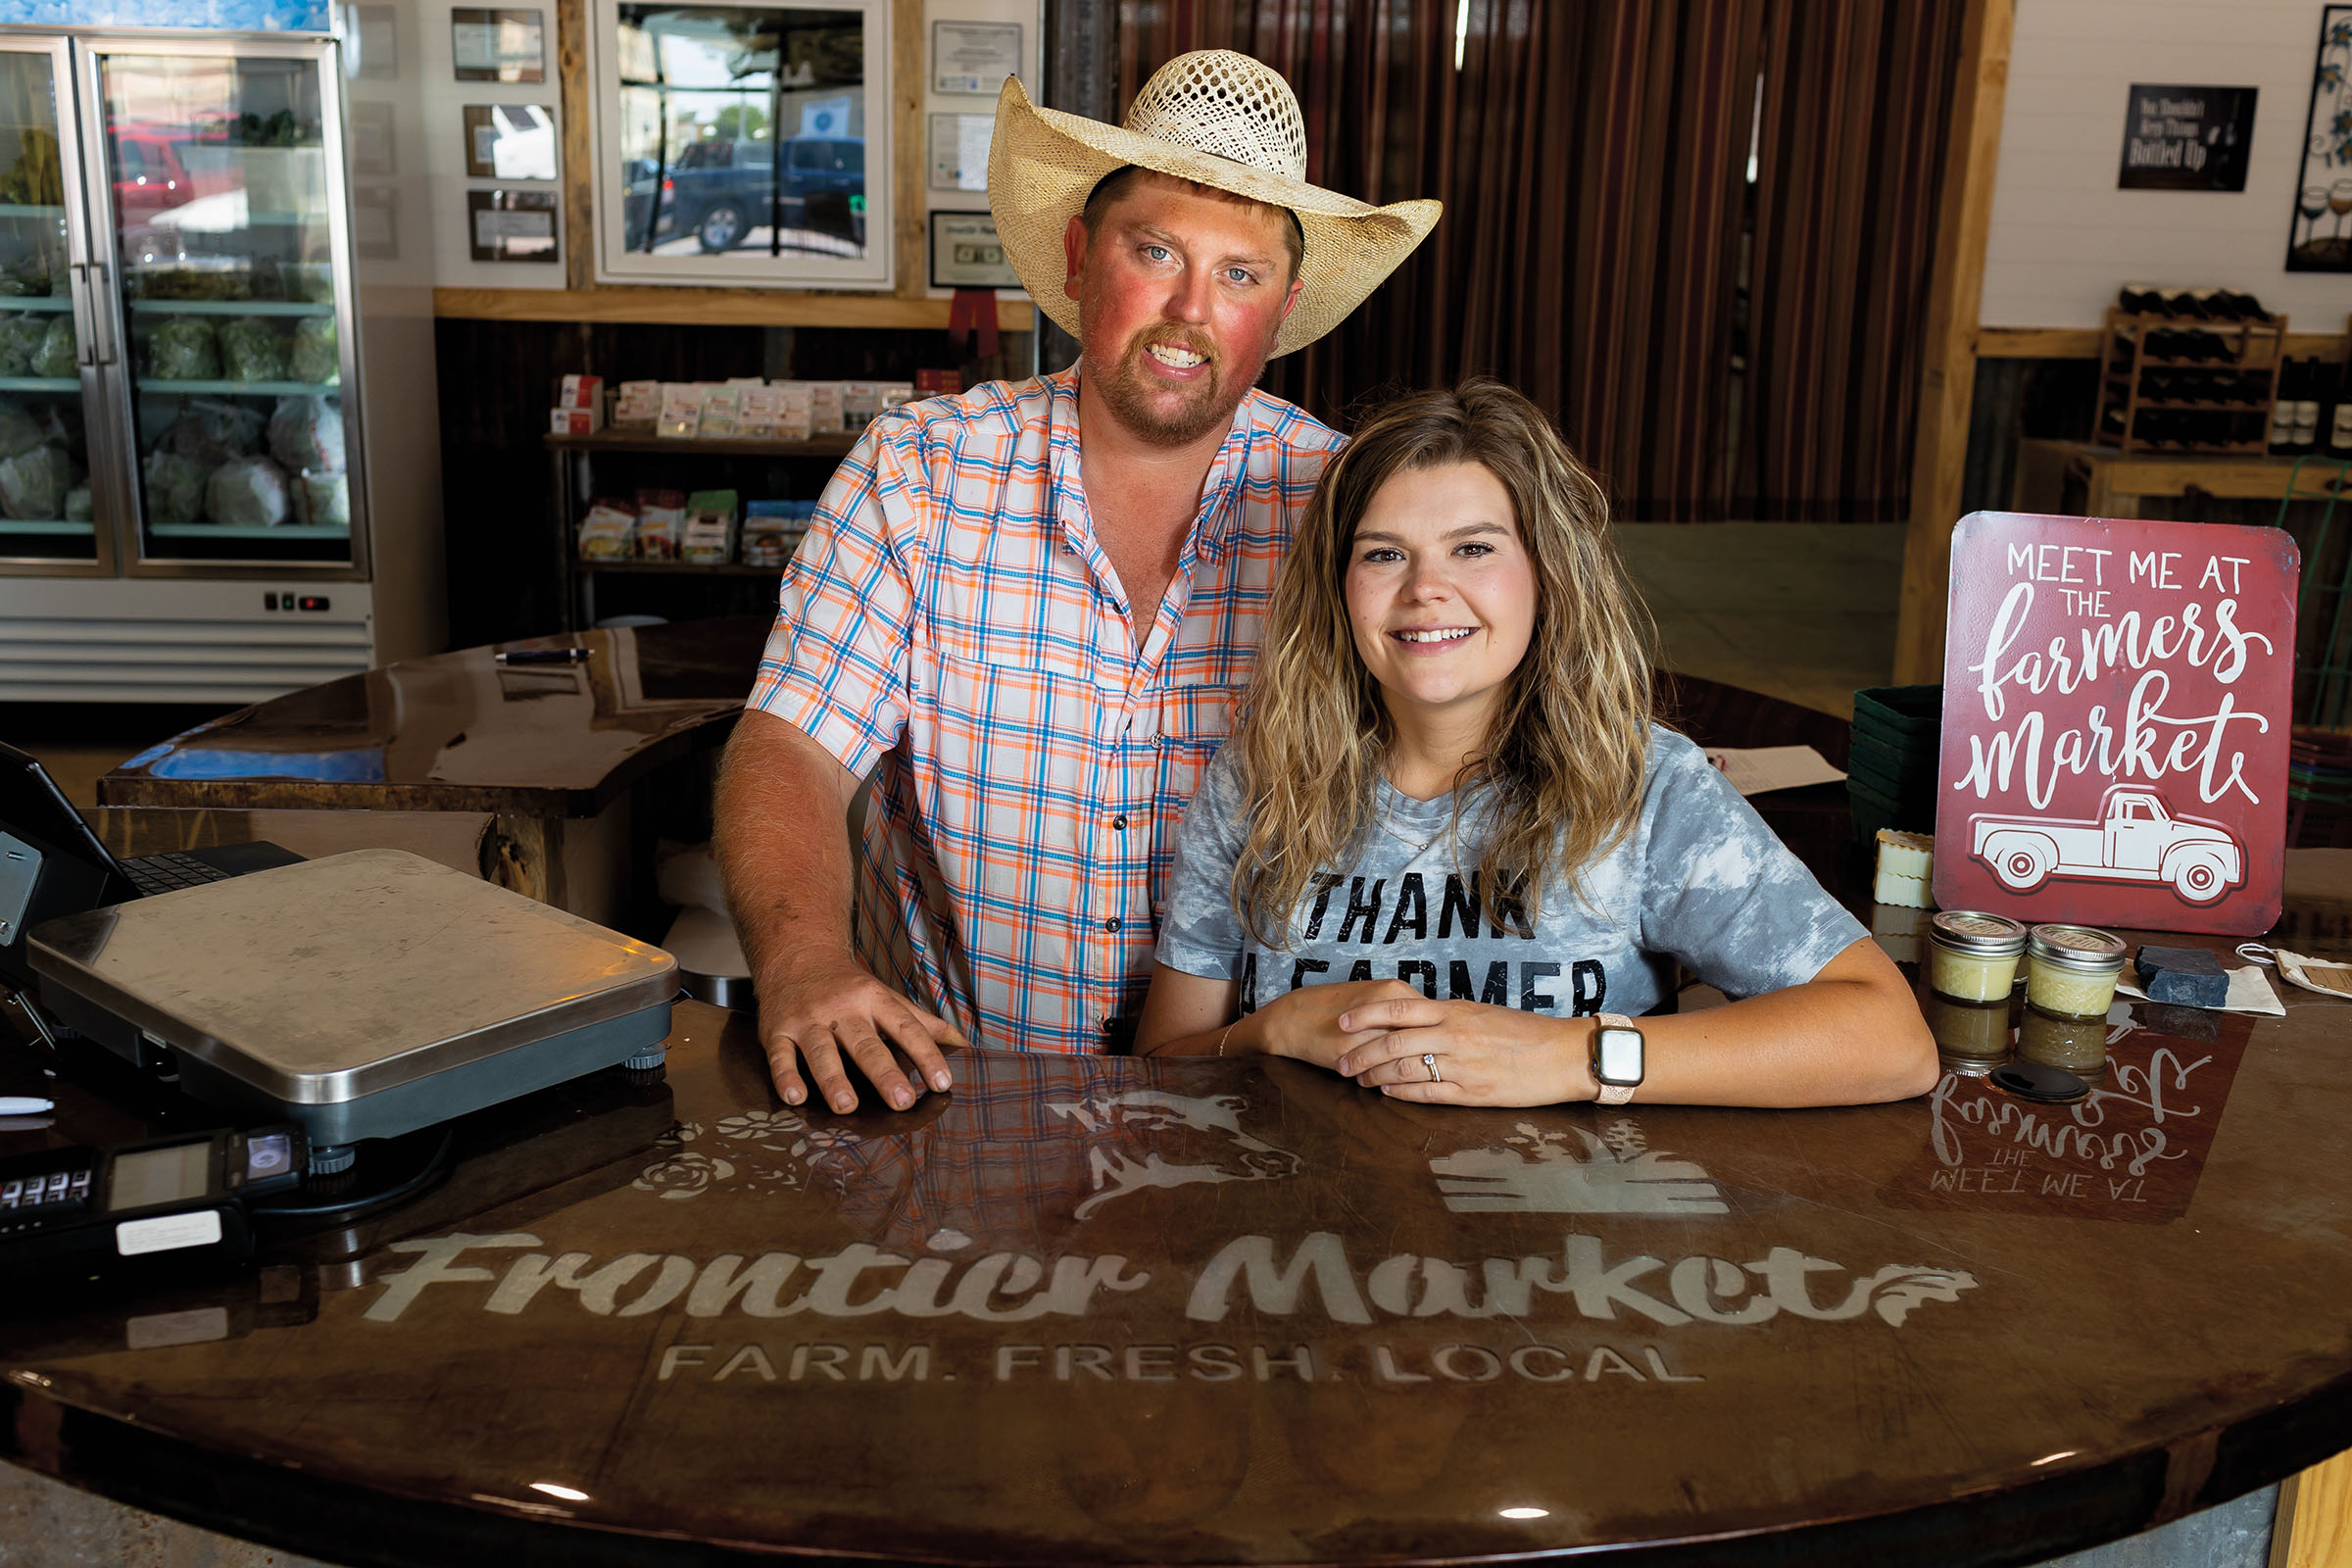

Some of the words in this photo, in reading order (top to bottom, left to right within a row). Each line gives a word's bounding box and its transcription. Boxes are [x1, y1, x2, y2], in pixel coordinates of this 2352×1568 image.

[2183, 138, 2207, 173] Up
[2008, 543, 2113, 586] MEET
[2129, 551, 2182, 589] ME
[2198, 555, 2251, 594] AT
[2058, 588, 2111, 617] THE
[1968, 582, 2274, 721] farmers
[1304, 868, 1537, 944] THANK
[363, 1228, 1152, 1325] Frontier
[1185, 1231, 1978, 1327] Market
[657, 1343, 957, 1383] FARM.
[995, 1343, 1344, 1383] FRESH.
[1376, 1343, 1705, 1383] LOCAL
